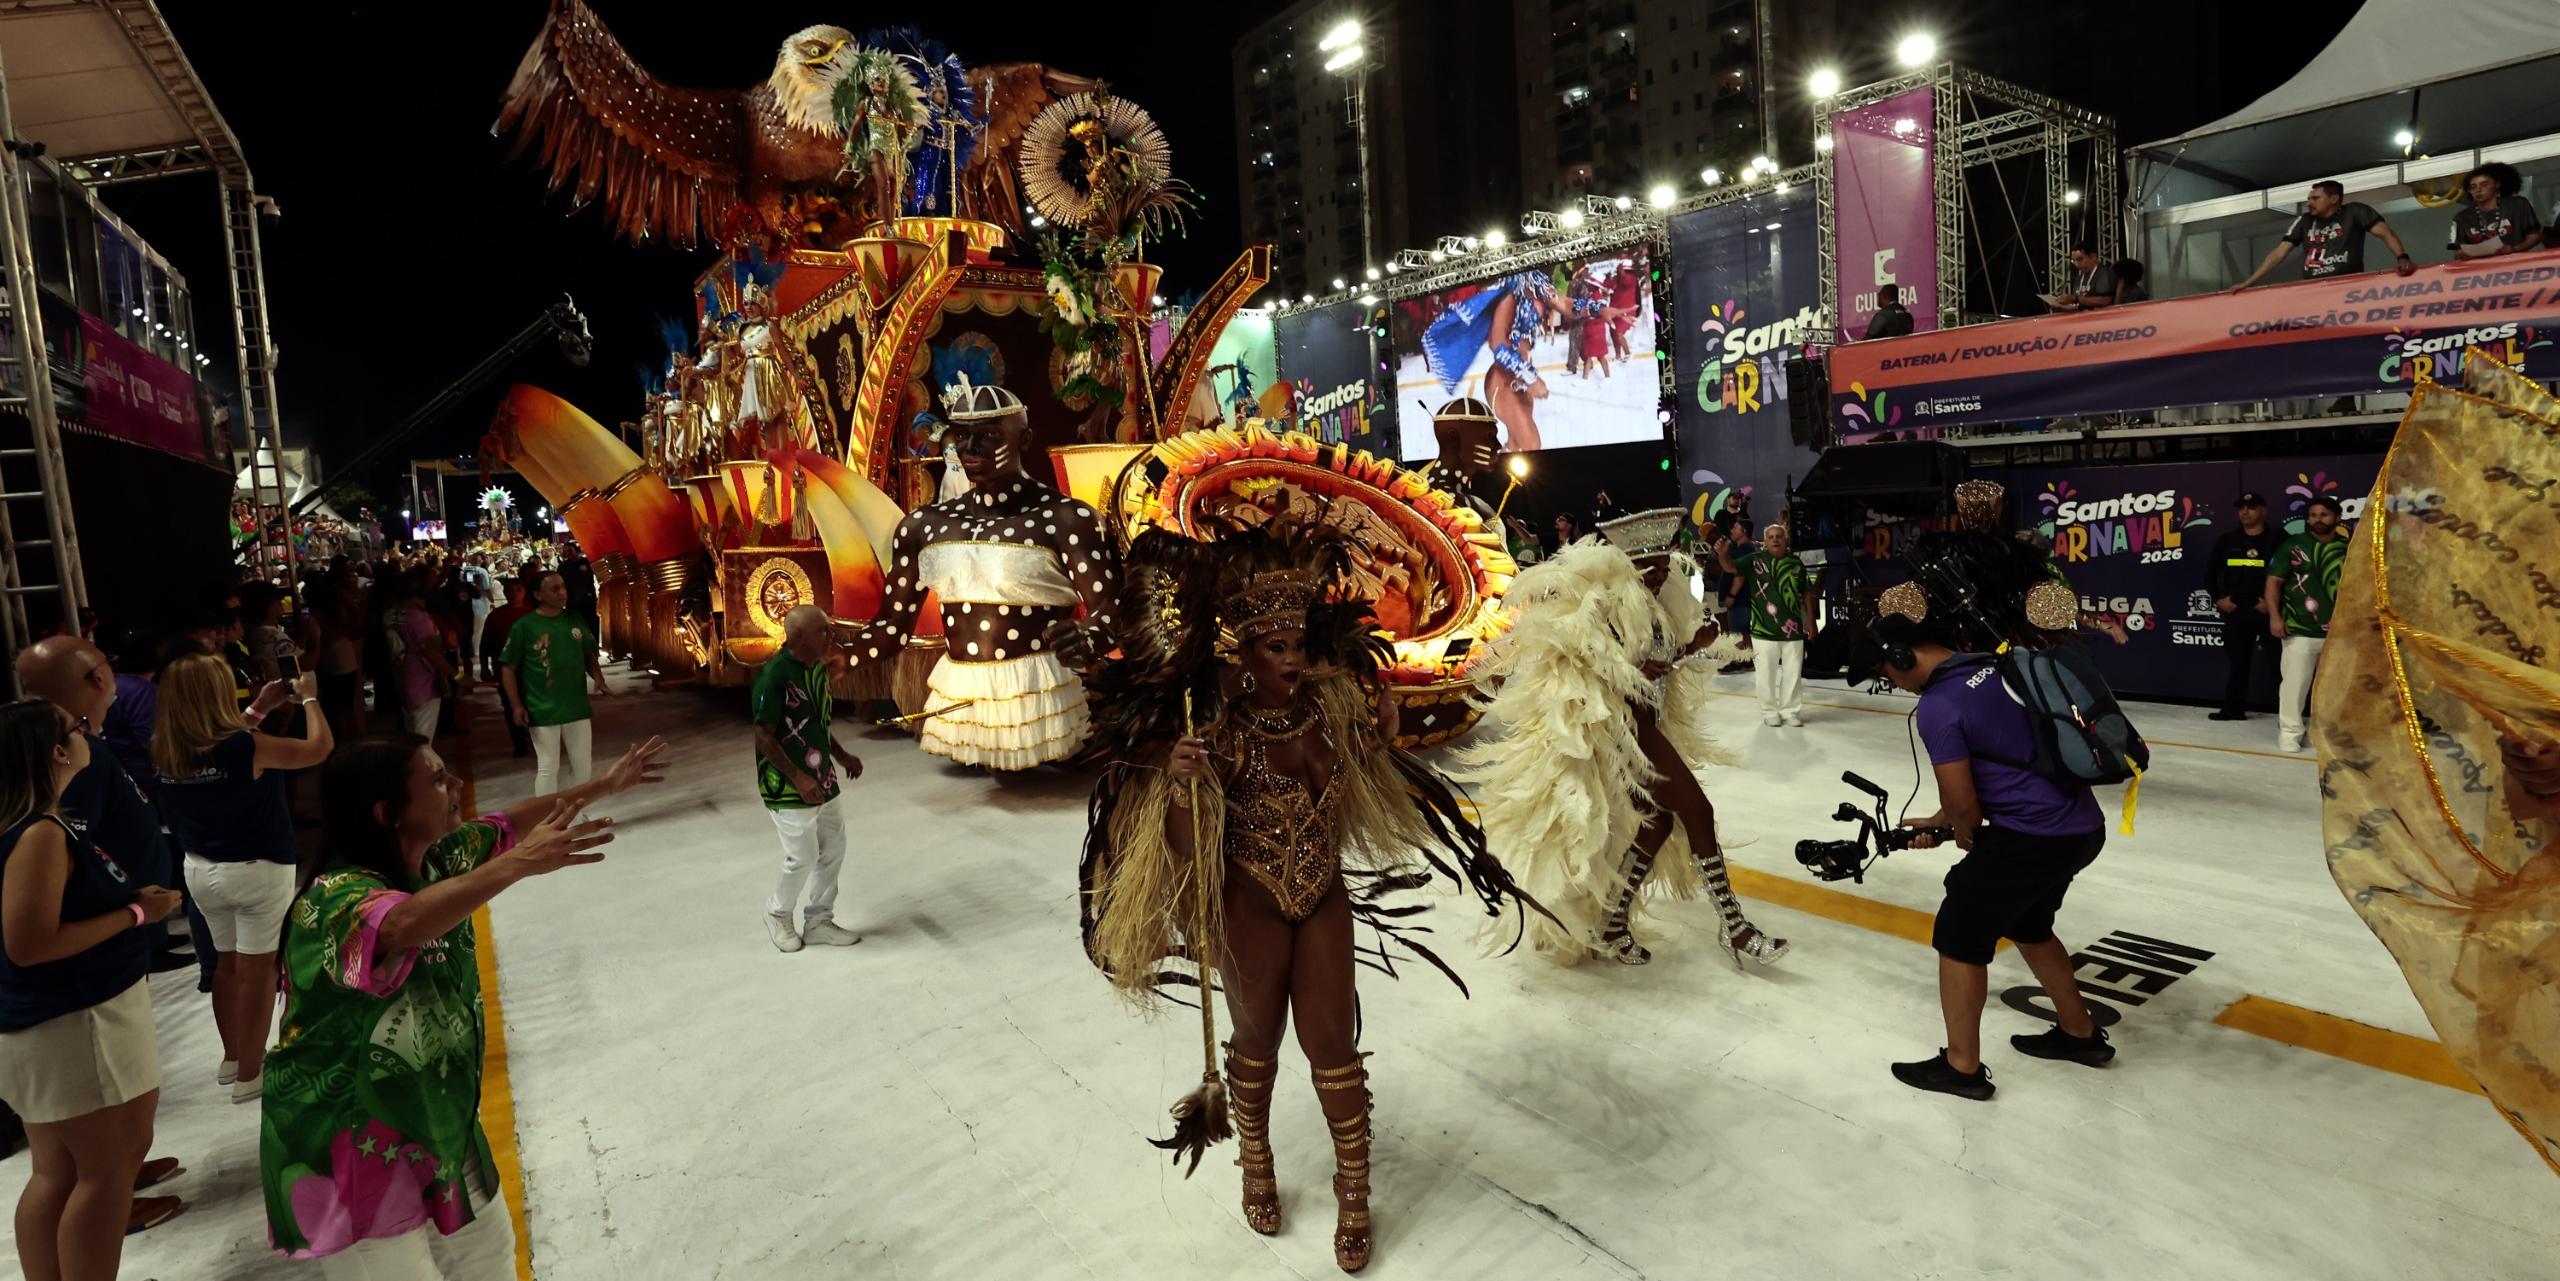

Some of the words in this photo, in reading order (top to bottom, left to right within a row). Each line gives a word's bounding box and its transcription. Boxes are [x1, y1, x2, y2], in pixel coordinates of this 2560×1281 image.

[1855, 286, 1918, 313] CULRA
[2345, 280, 2444, 304] SAMBA
[2228, 309, 2360, 338] COMISSÃO
[2366, 306, 2403, 323] DE
[2409, 292, 2523, 319] FRENTE
[1880, 352, 1947, 371] BATERIA
[1962, 335, 2058, 361] EVOLUÇÃO
[2074, 325, 2157, 347] ENREDO
[2401, 323, 2519, 357] Santos
[1304, 379, 1365, 421] Santos
[1934, 402, 1982, 414] Santos
[2055, 490, 2176, 526] Santos
[2141, 548, 2183, 564] 2026
[2081, 595, 2155, 615] LIGA
[2173, 624, 2223, 634] PREFEITURA
[1966, 666, 1995, 688] REPO
[2001, 930, 2216, 1027] MEIO
